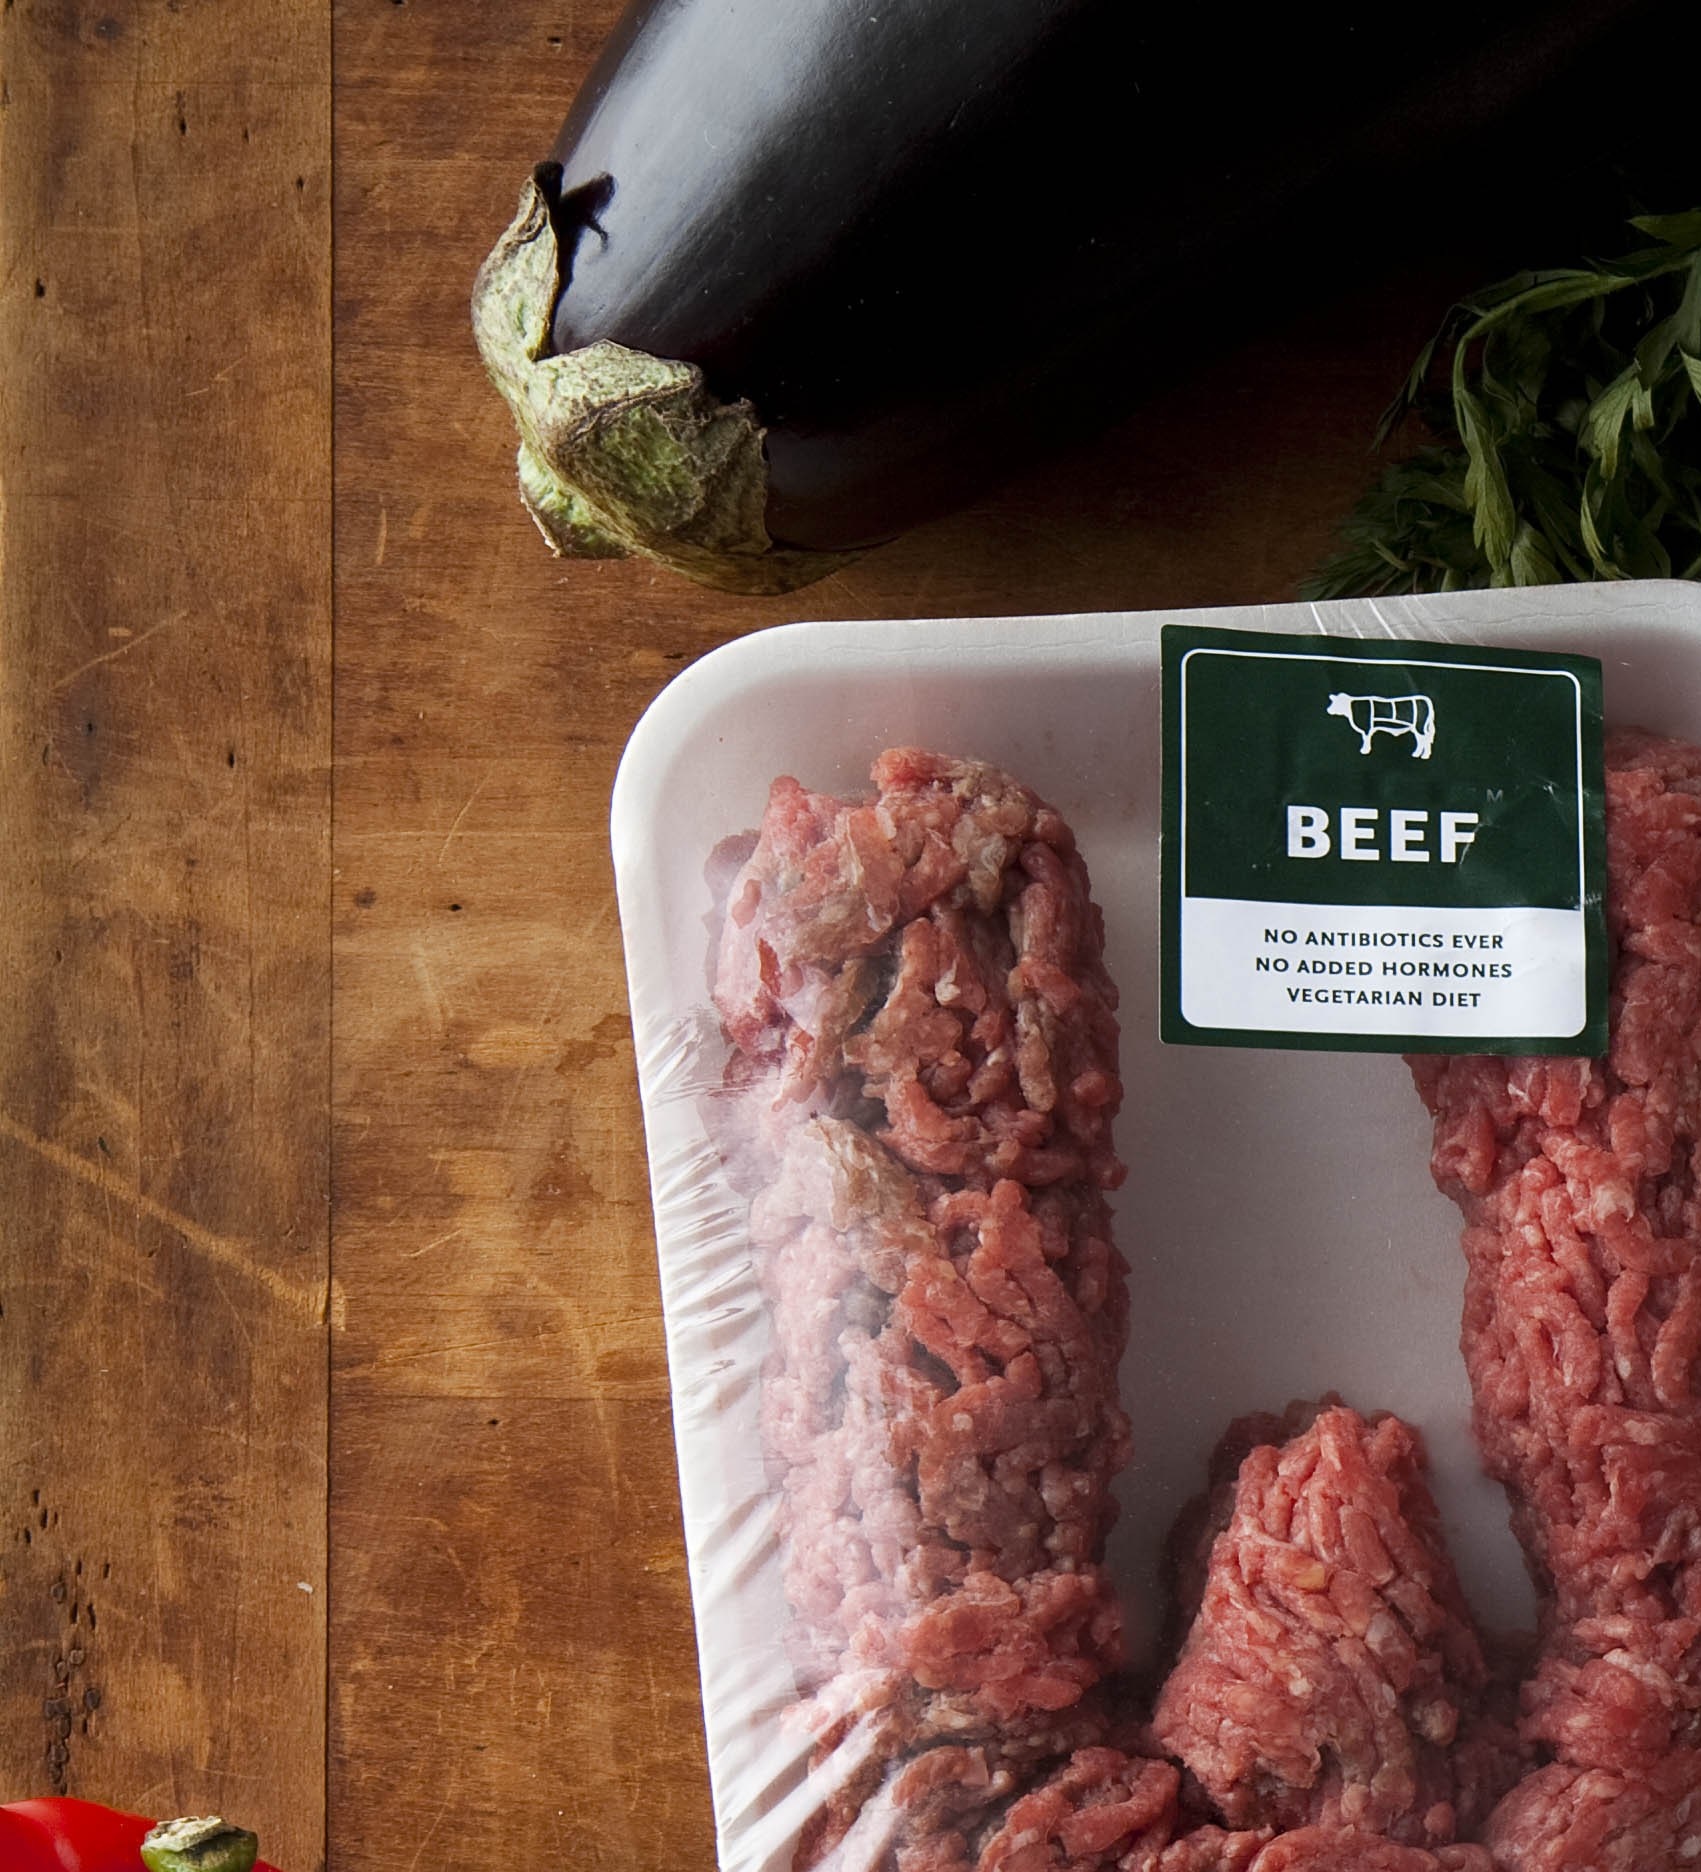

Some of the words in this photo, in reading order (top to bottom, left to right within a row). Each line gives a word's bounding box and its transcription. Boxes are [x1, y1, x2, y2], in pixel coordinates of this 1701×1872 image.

[1287, 805, 1479, 863] BEEF
[1264, 928, 1297, 945] NO
[1305, 931, 1444, 949] ANTIBIOTICS
[1452, 934, 1503, 949] EVER
[1256, 957, 1289, 972] NO
[1297, 959, 1372, 976] ADDED
[1383, 962, 1512, 978] HORMONES
[1287, 987, 1423, 1006] VEGETARIAN
[1432, 992, 1481, 1007] DIET
